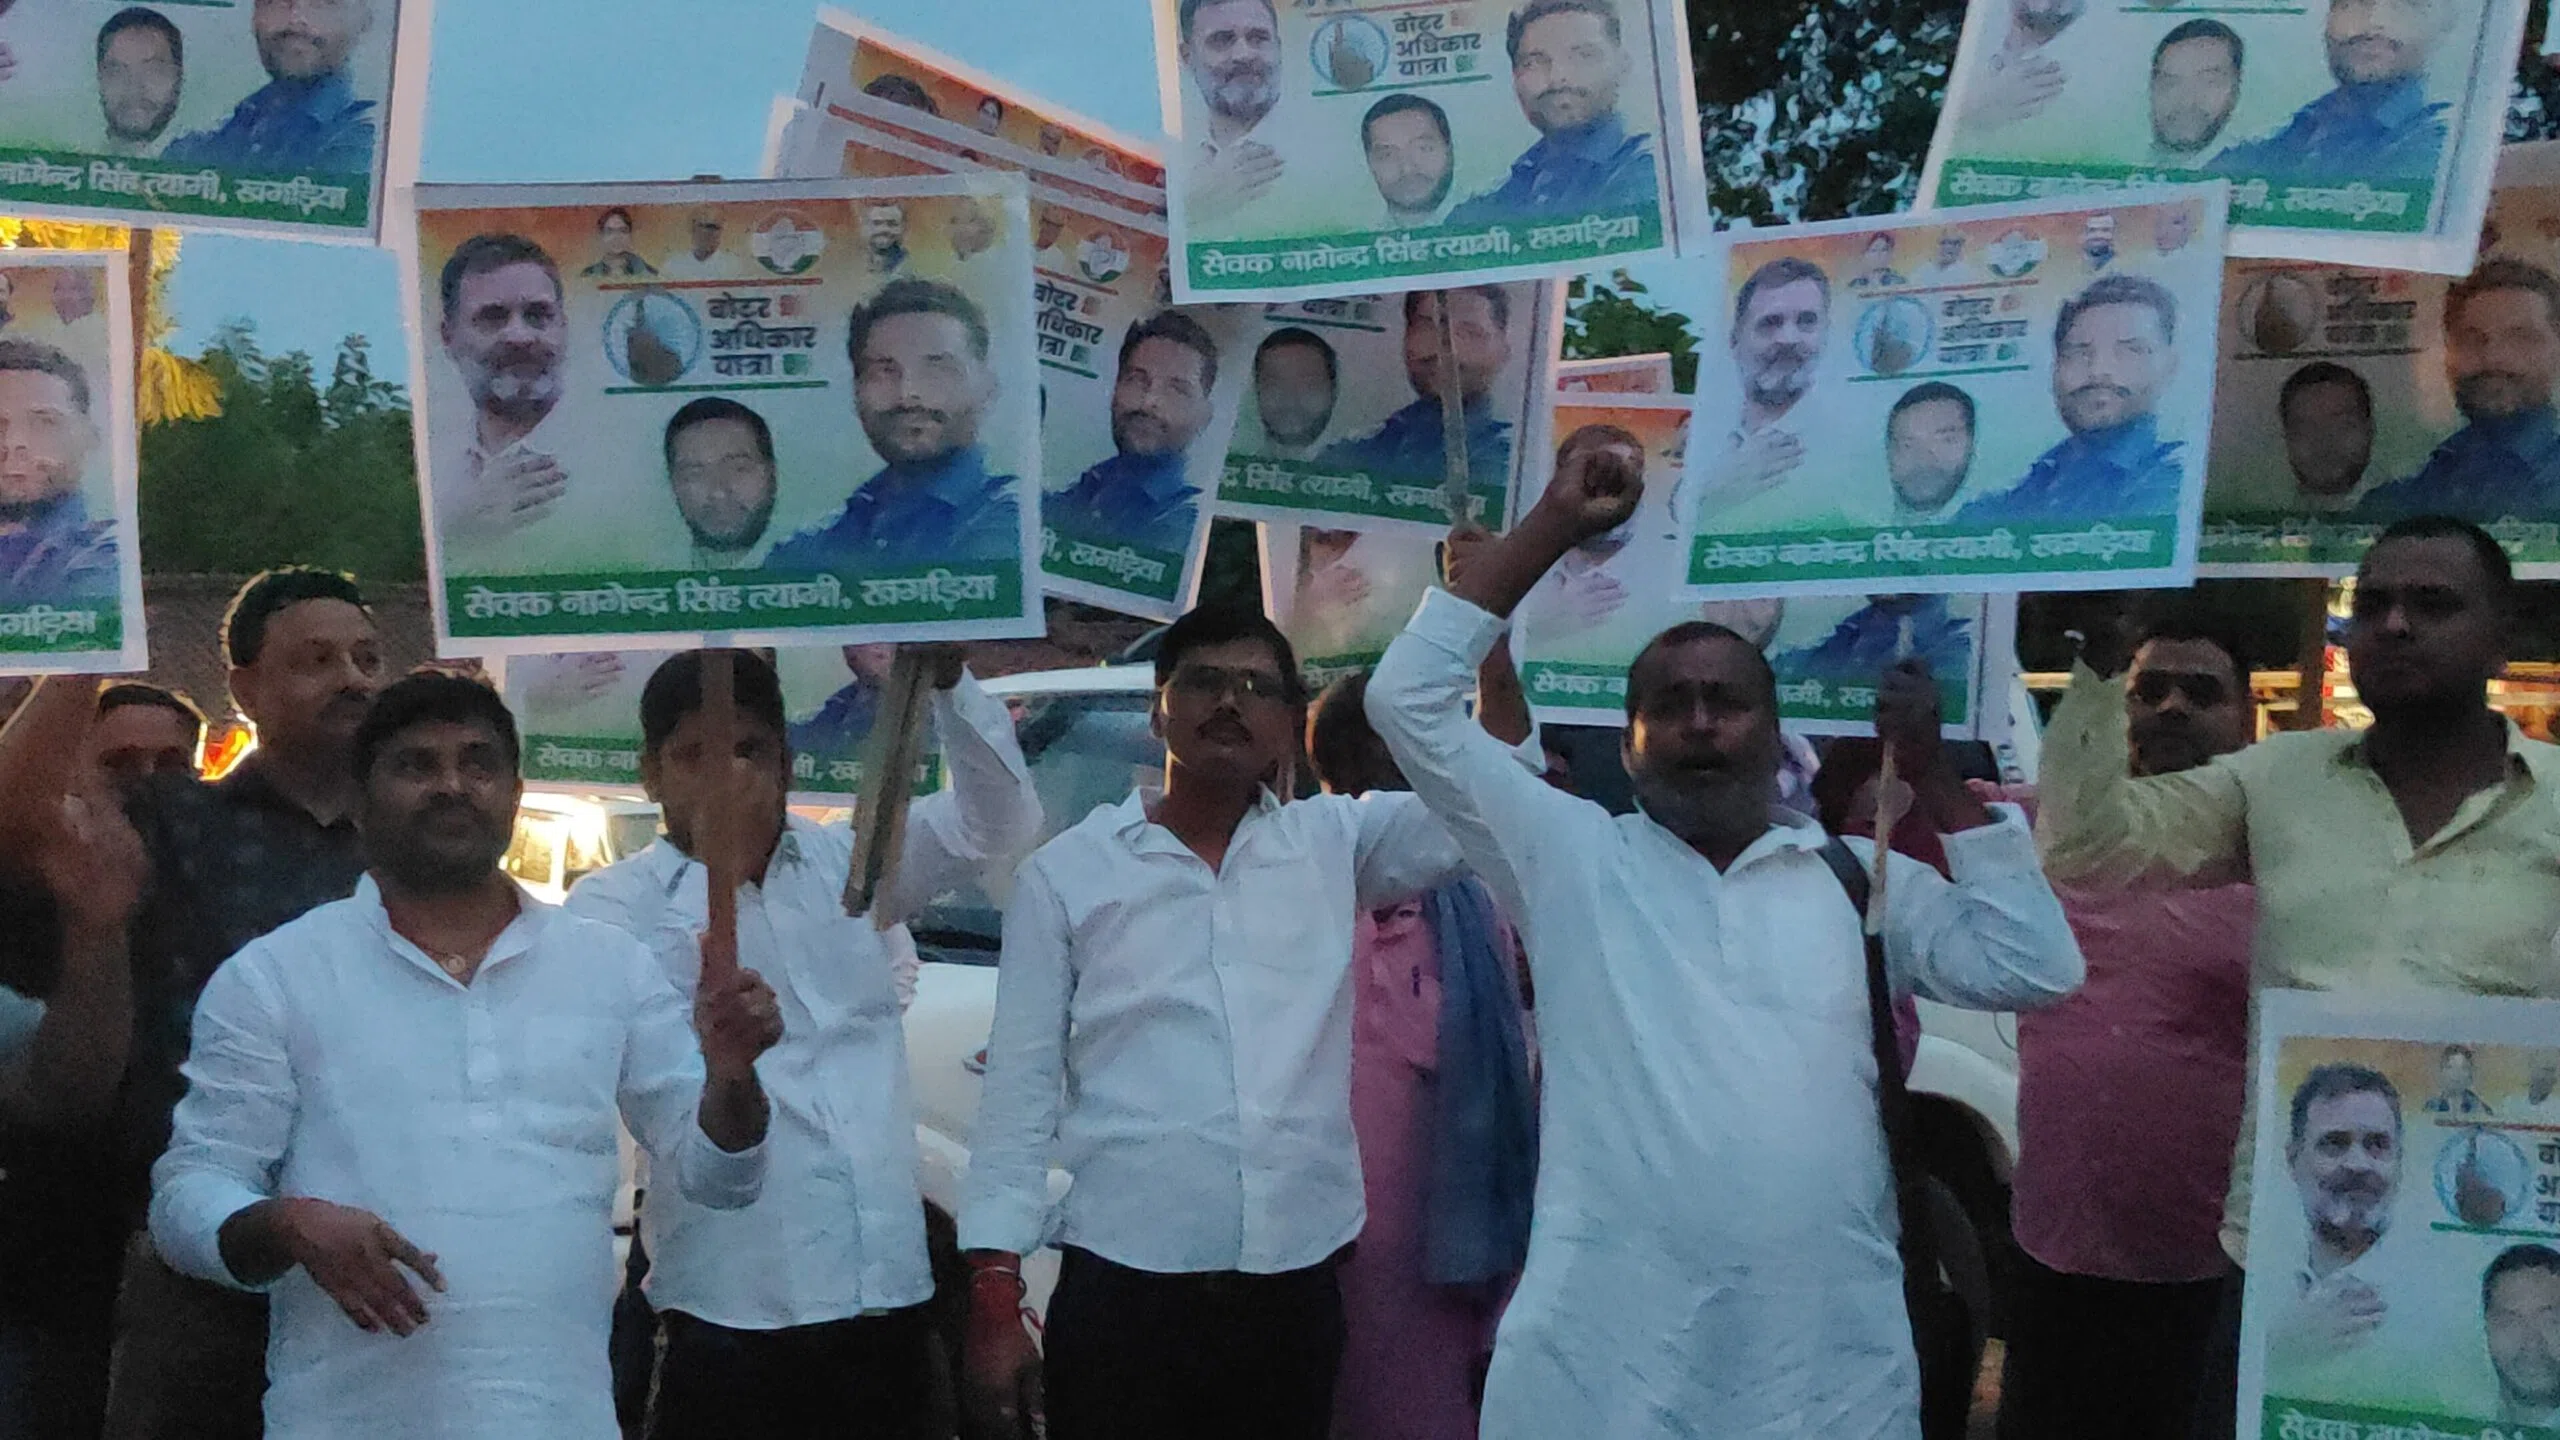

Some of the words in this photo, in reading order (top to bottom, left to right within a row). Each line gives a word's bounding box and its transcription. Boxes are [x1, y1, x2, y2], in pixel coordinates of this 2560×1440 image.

[1394, 12, 1445, 33] वोटर
[1396, 32, 1482, 58] अधिकार
[1399, 56, 1448, 77] यात्रा
[1202, 249, 1275, 276] सेवक
[1280, 243, 1372, 270] नागेन्द्र
[1374, 233, 1430, 264] सिंह
[1434, 225, 1522, 256] त्यागी,
[1527, 214, 1641, 249] खगड़िया
[706, 291, 774, 319] वोटर
[708, 320, 817, 349] अधिकार
[710, 353, 774, 376] यात्रा
[1069, 541, 1167, 584] खगड़िया
[463, 585, 554, 618] सेवक
[558, 581, 672, 616] नागेन्द्र
[675, 575, 742, 613] सिंह
[747, 573, 853, 611] त्यागी,
[859, 568, 998, 613] खगड़िया
